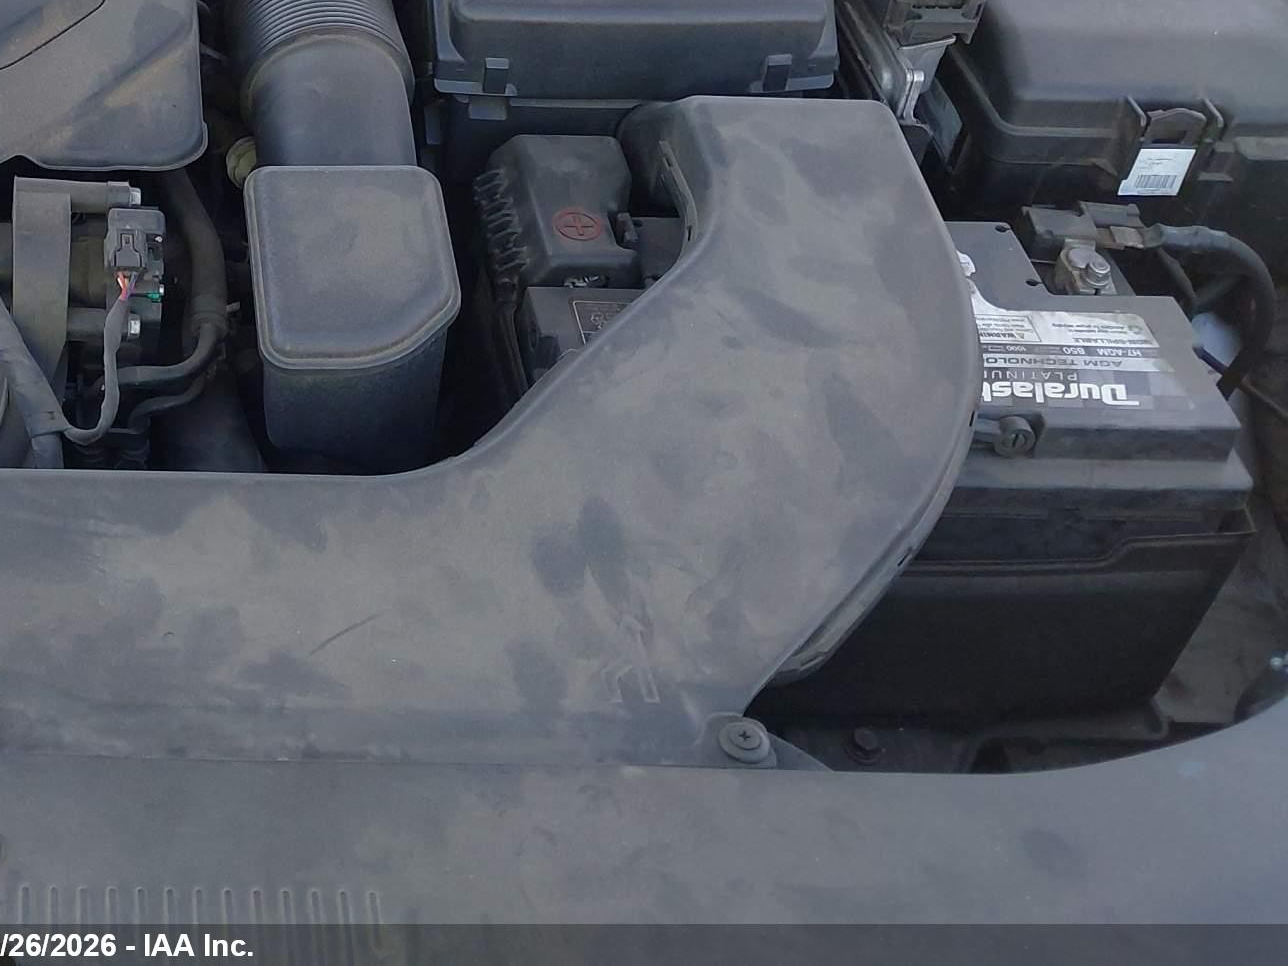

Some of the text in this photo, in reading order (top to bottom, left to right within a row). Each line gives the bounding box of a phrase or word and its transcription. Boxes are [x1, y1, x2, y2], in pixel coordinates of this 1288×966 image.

[985, 357, 1124, 368] AGM TECHNOLO
[983, 370, 1079, 382] PLATINU
[982, 382, 1140, 405] Duralast
